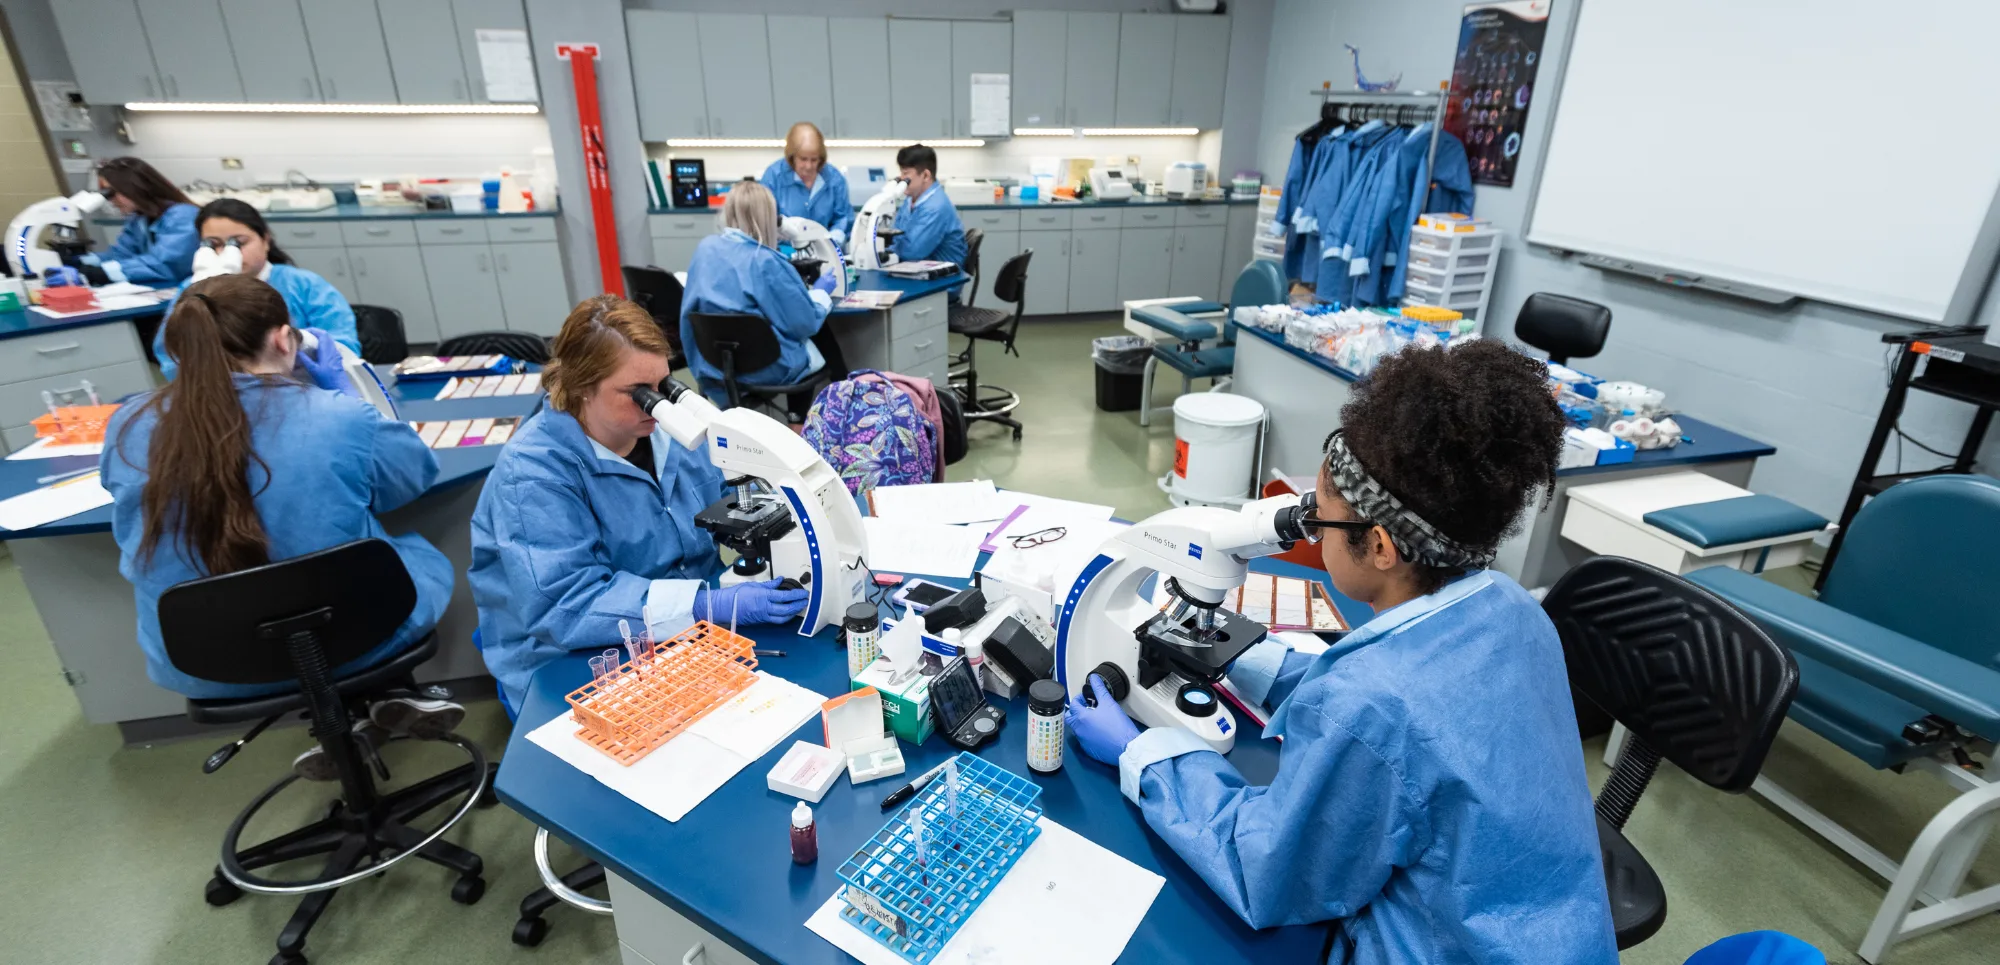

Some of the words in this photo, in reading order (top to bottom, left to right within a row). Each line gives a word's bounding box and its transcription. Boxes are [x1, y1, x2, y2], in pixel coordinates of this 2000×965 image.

[736, 444, 752, 453] Primo
[752, 447, 764, 455] Star
[1144, 531, 1162, 544] Primo
[1164, 539, 1177, 550] Star
